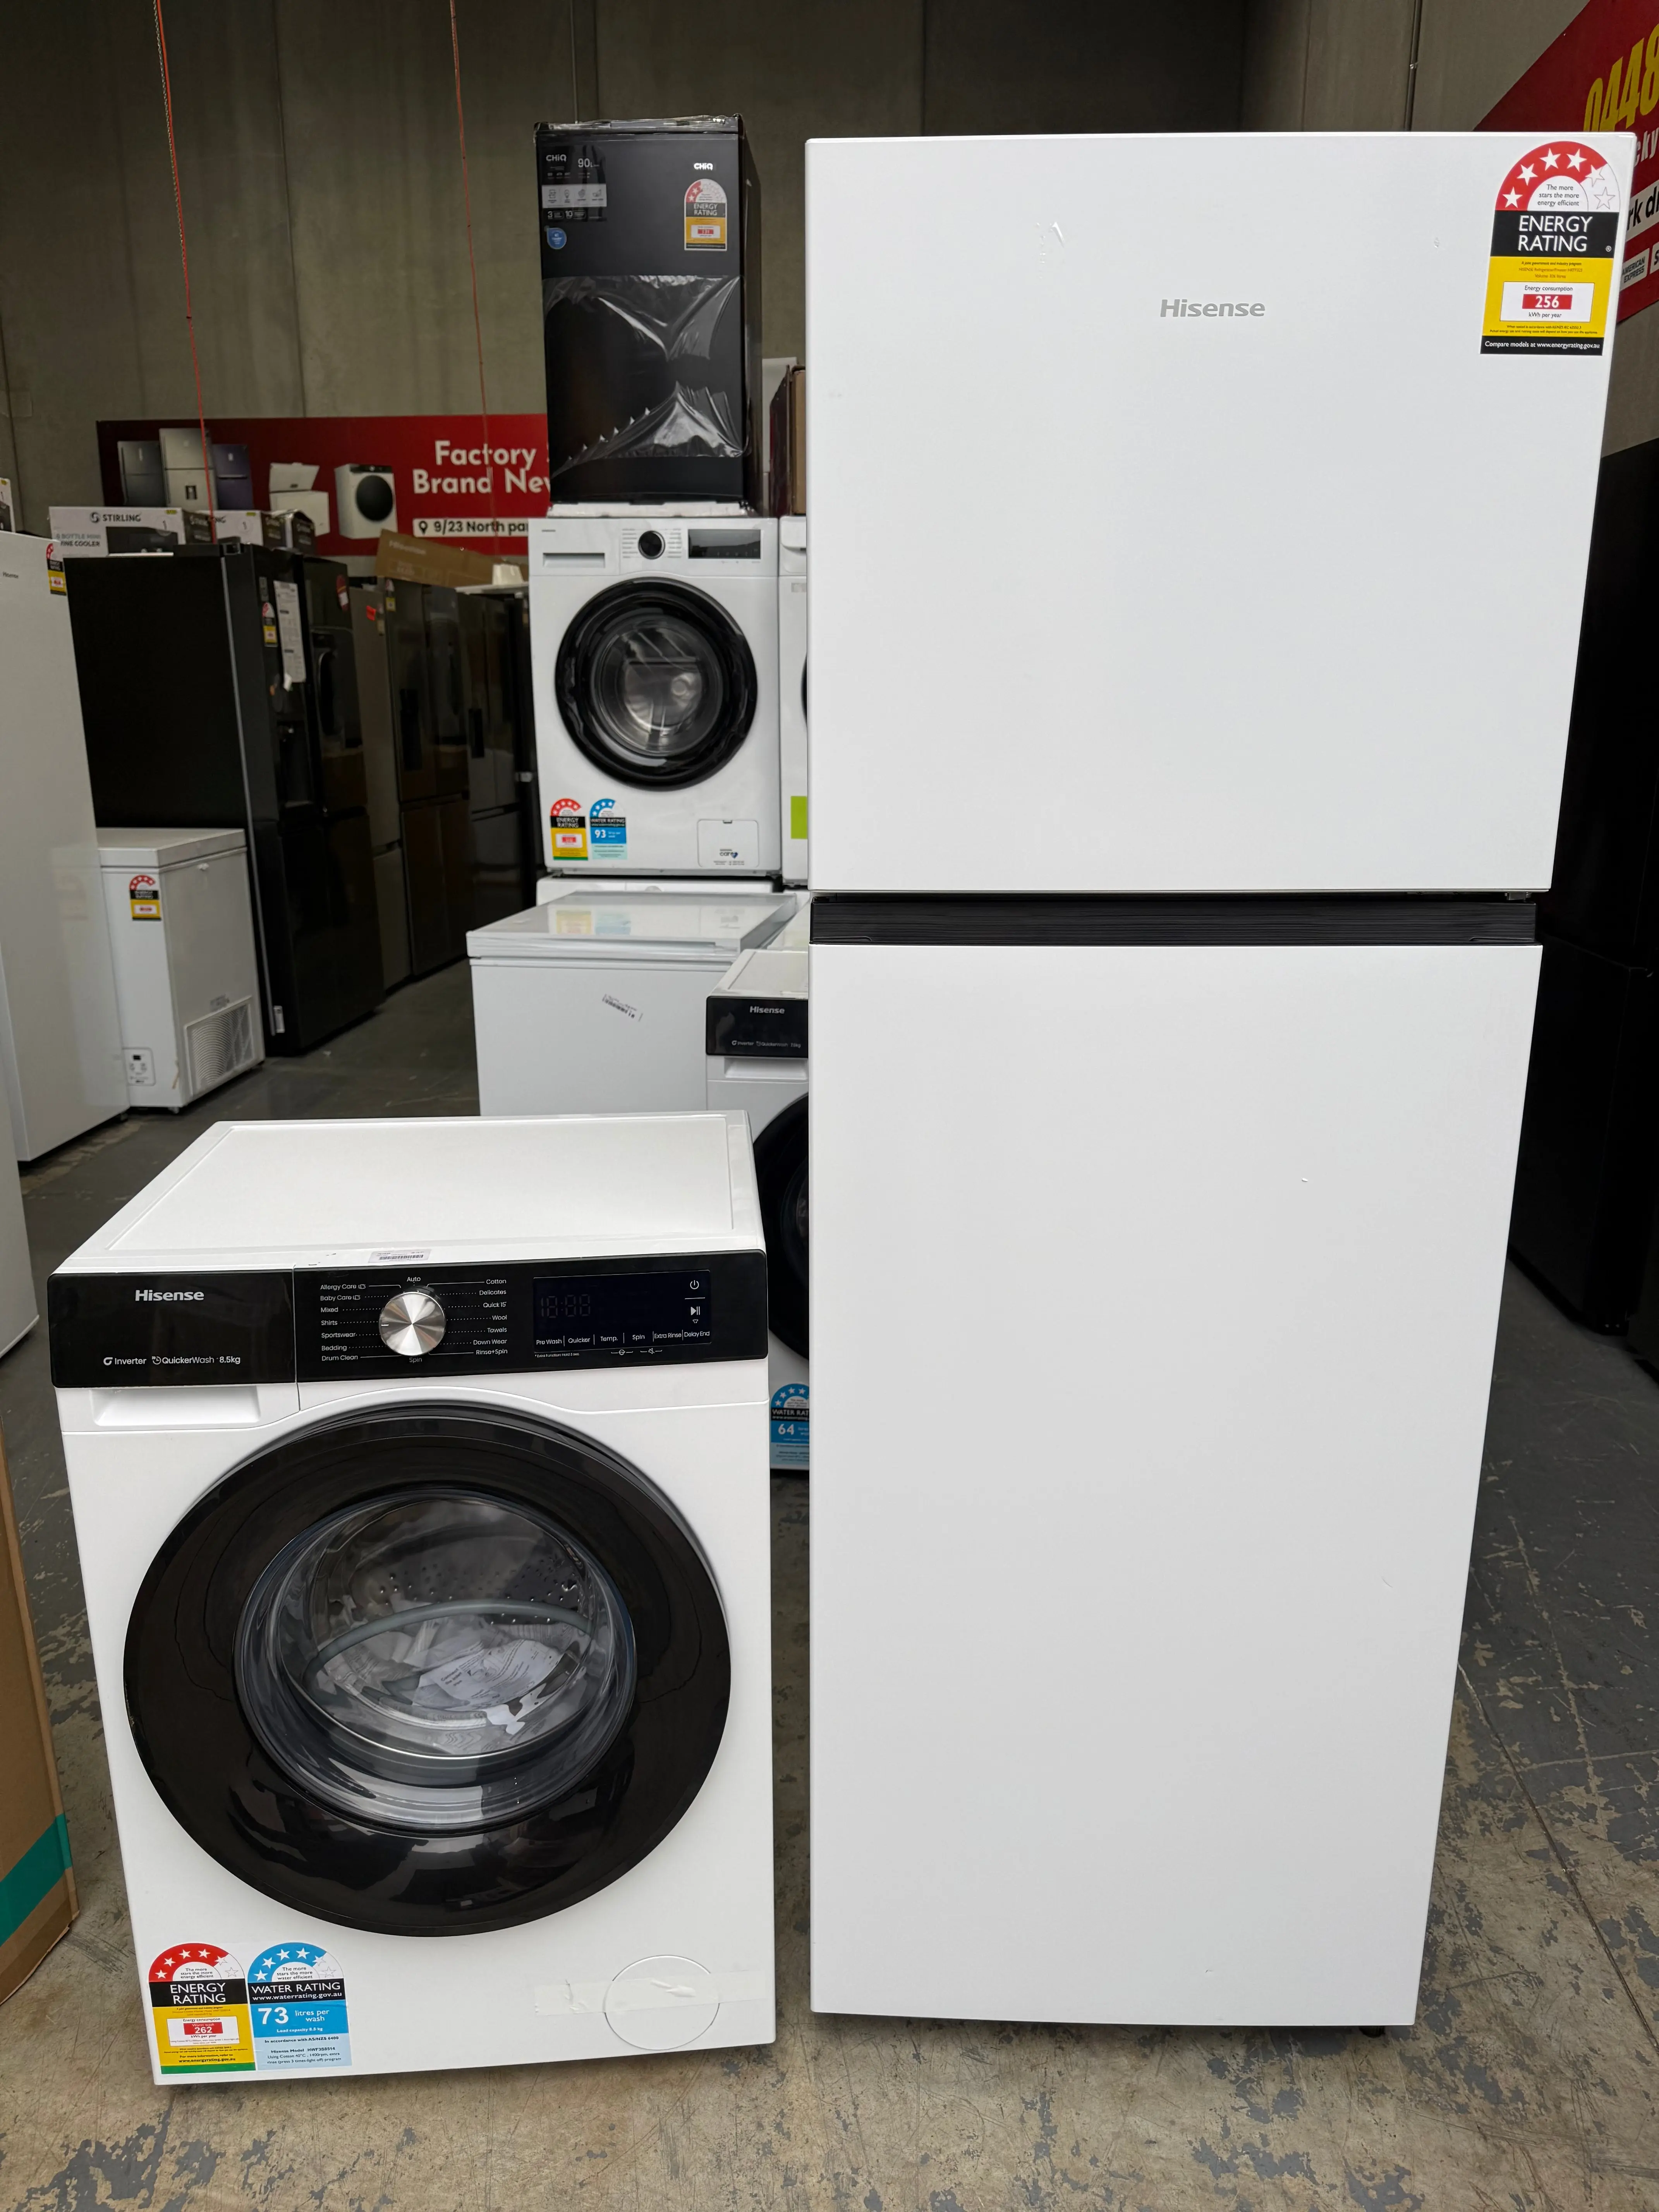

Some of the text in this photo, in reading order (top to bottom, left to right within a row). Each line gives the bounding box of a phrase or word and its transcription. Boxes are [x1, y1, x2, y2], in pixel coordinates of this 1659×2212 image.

[1518, 215, 1593, 233] ENERGY
[1518, 235, 1588, 252] RATING
[1535, 295, 1559, 308] 256
[1160, 299, 1265, 317] Hisense
[434, 440, 537, 471] Factory
[412, 467, 493, 494] Brand
[102, 514, 142, 522] STIRLING
[434, 520, 463, 535] 9/23
[466, 520, 504, 532] North
[595, 830, 606, 838] 93
[750, 1006, 785, 1014] Hisense
[135, 1290, 204, 1301] Hisense
[162, 1356, 215, 1364] QuickerWash
[219, 1356, 241, 1365] 8.5kg
[778, 1424, 794, 1435] 64
[170, 1982, 226, 1994] ENERGY
[251, 1982, 341, 1994] WATER RATING
[173, 1994, 226, 2004] RATING
[252, 1992, 342, 2001] www.waterrating.gov.au
[258, 2007, 289, 2025] 73
